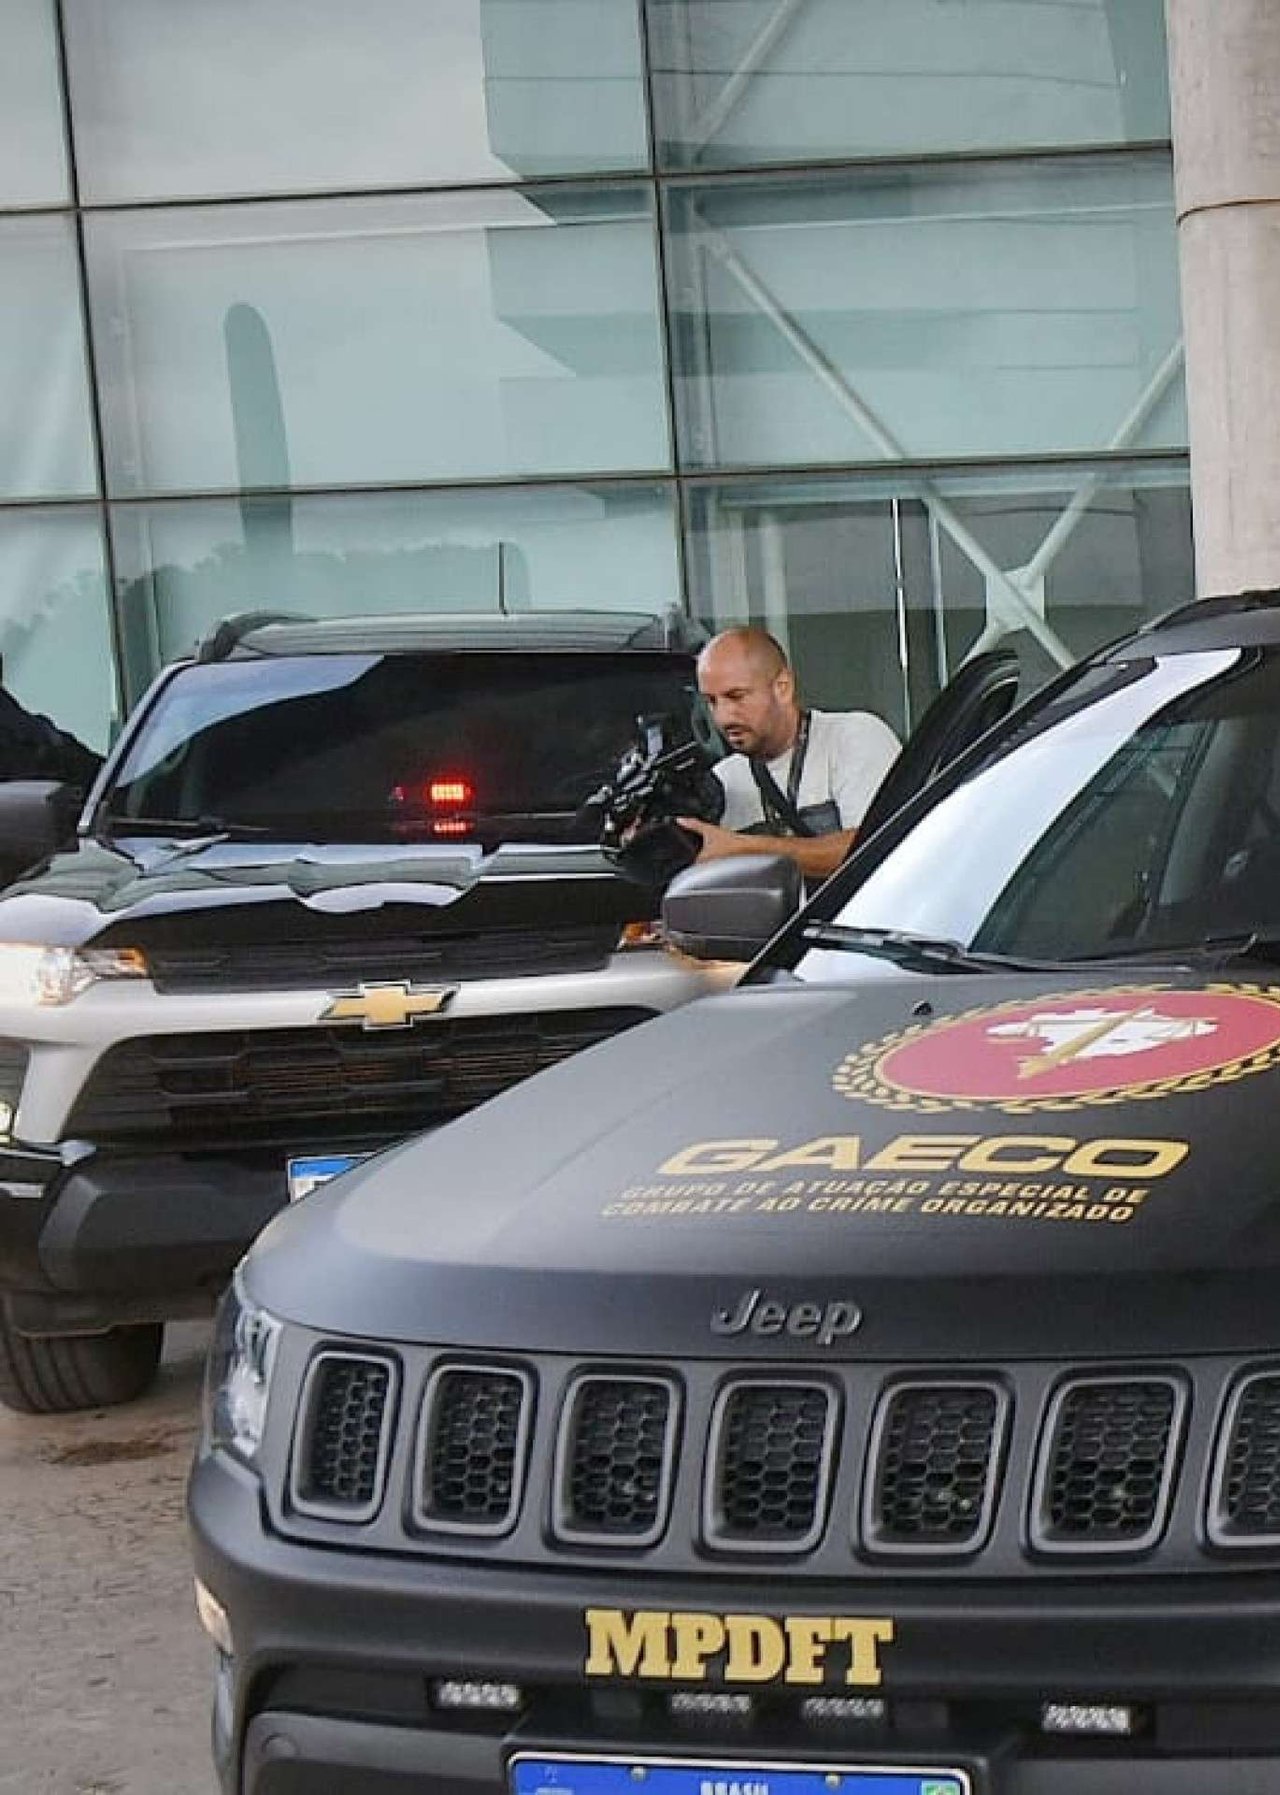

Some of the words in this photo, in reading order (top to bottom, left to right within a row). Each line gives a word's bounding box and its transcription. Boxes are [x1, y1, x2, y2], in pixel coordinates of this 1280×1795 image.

[656, 1133, 1190, 1178] GAECO
[601, 1198, 752, 1217] COMBATE
[755, 1196, 802, 1212] AO
[806, 1196, 915, 1214] CRIME
[920, 1198, 1135, 1221] ORGANIZADO
[621, 1183, 728, 1199] GRUPO
[735, 1180, 778, 1195] DE
[781, 1178, 931, 1197] ATUAÇÃO
[937, 1180, 1091, 1198] ESPECIAL
[1103, 1186, 1149, 1203] DE
[710, 1288, 863, 1345] Jeep
[584, 1608, 895, 1686] MPDFT
